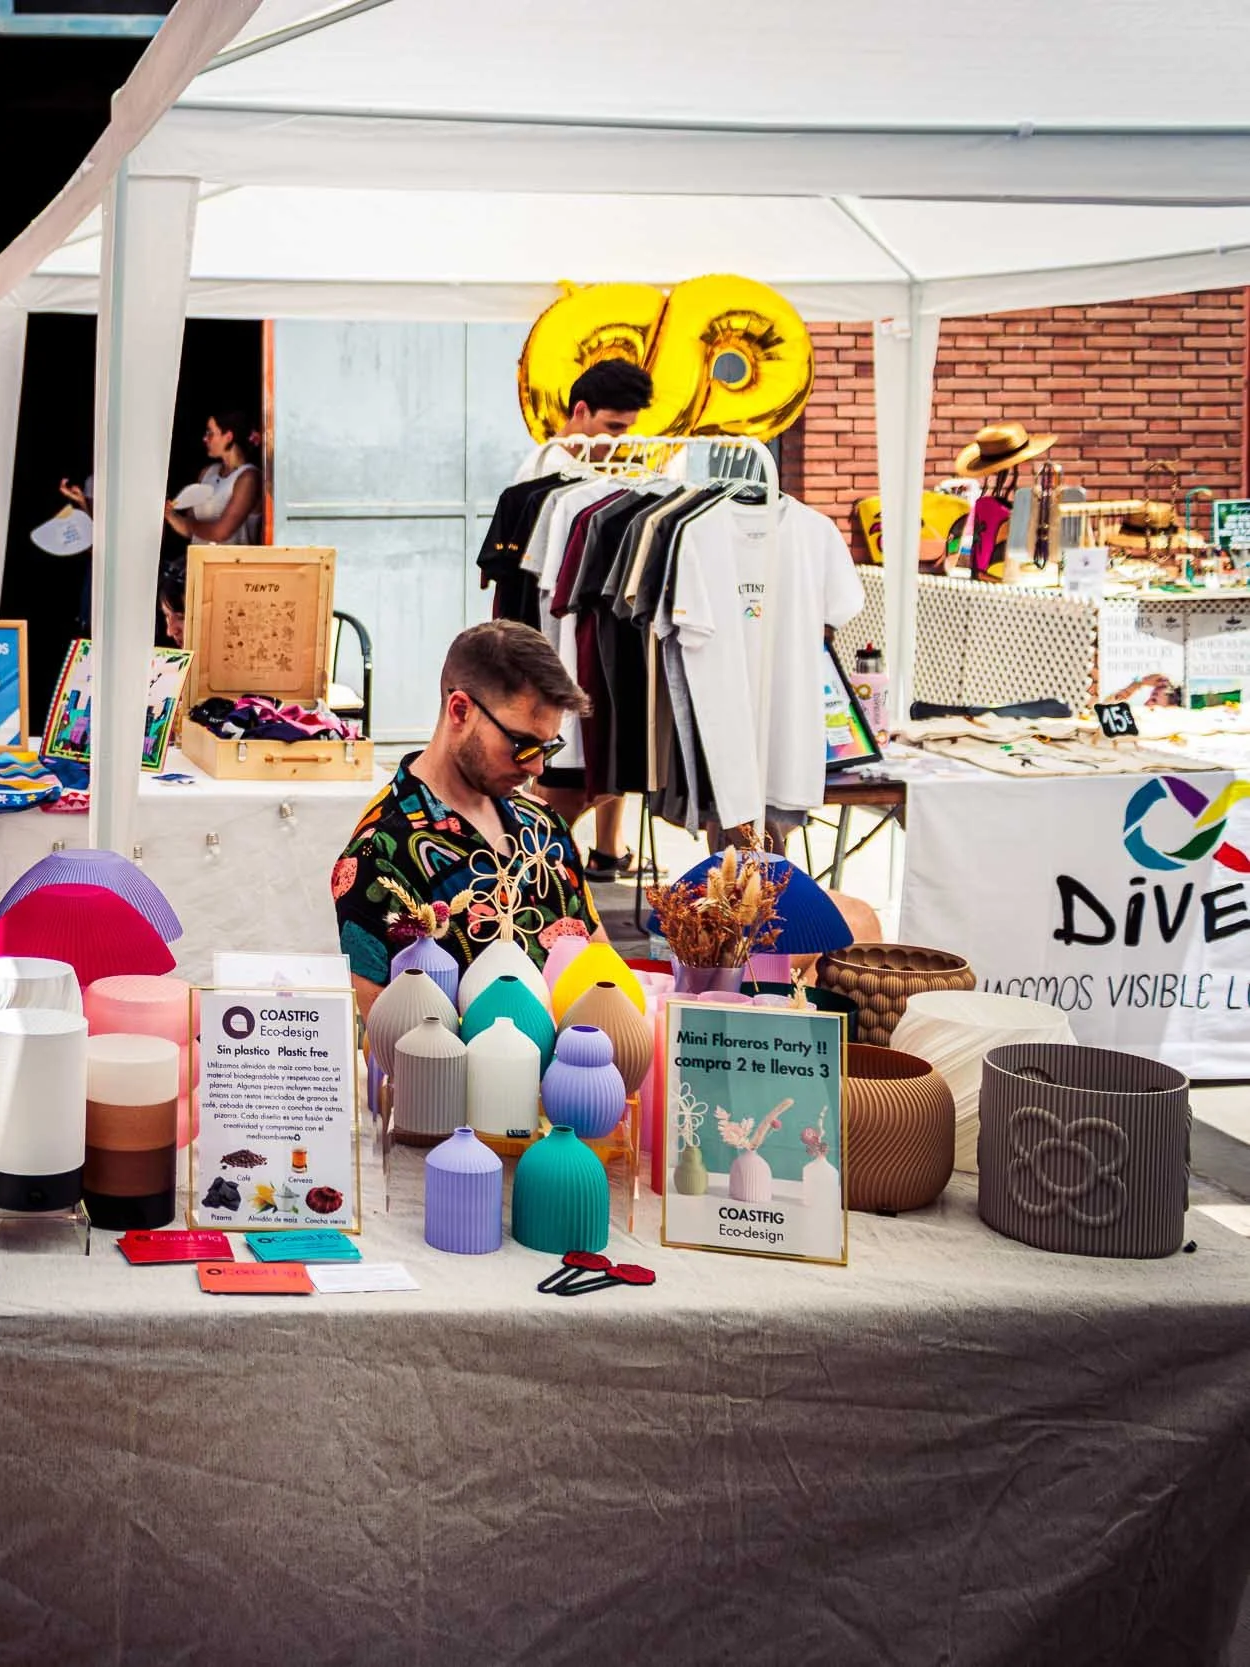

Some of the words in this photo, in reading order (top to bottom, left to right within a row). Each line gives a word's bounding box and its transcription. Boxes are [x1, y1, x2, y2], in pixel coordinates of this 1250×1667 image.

[244, 582, 280, 592] TIENTO
[1108, 973, 1213, 1010] VISIBLE
[260, 1009, 319, 1022] COASTFIG
[260, 1025, 319, 1040] Eco-design
[217, 1045, 231, 1055] Sin
[278, 1046, 307, 1057] Plastic
[310, 1047, 328, 1057] free
[676, 1031, 708, 1045] Mini
[712, 1032, 769, 1050] Floreros
[773, 1038, 812, 1057] Party
[674, 1057, 731, 1074] compra
[737, 1057, 747, 1072] 2
[751, 1060, 766, 1074] te
[770, 1058, 815, 1077] llevas
[819, 1063, 830, 1079] 3
[718, 1207, 785, 1225] COASTFIG
[719, 1223, 784, 1244] Eco-design
